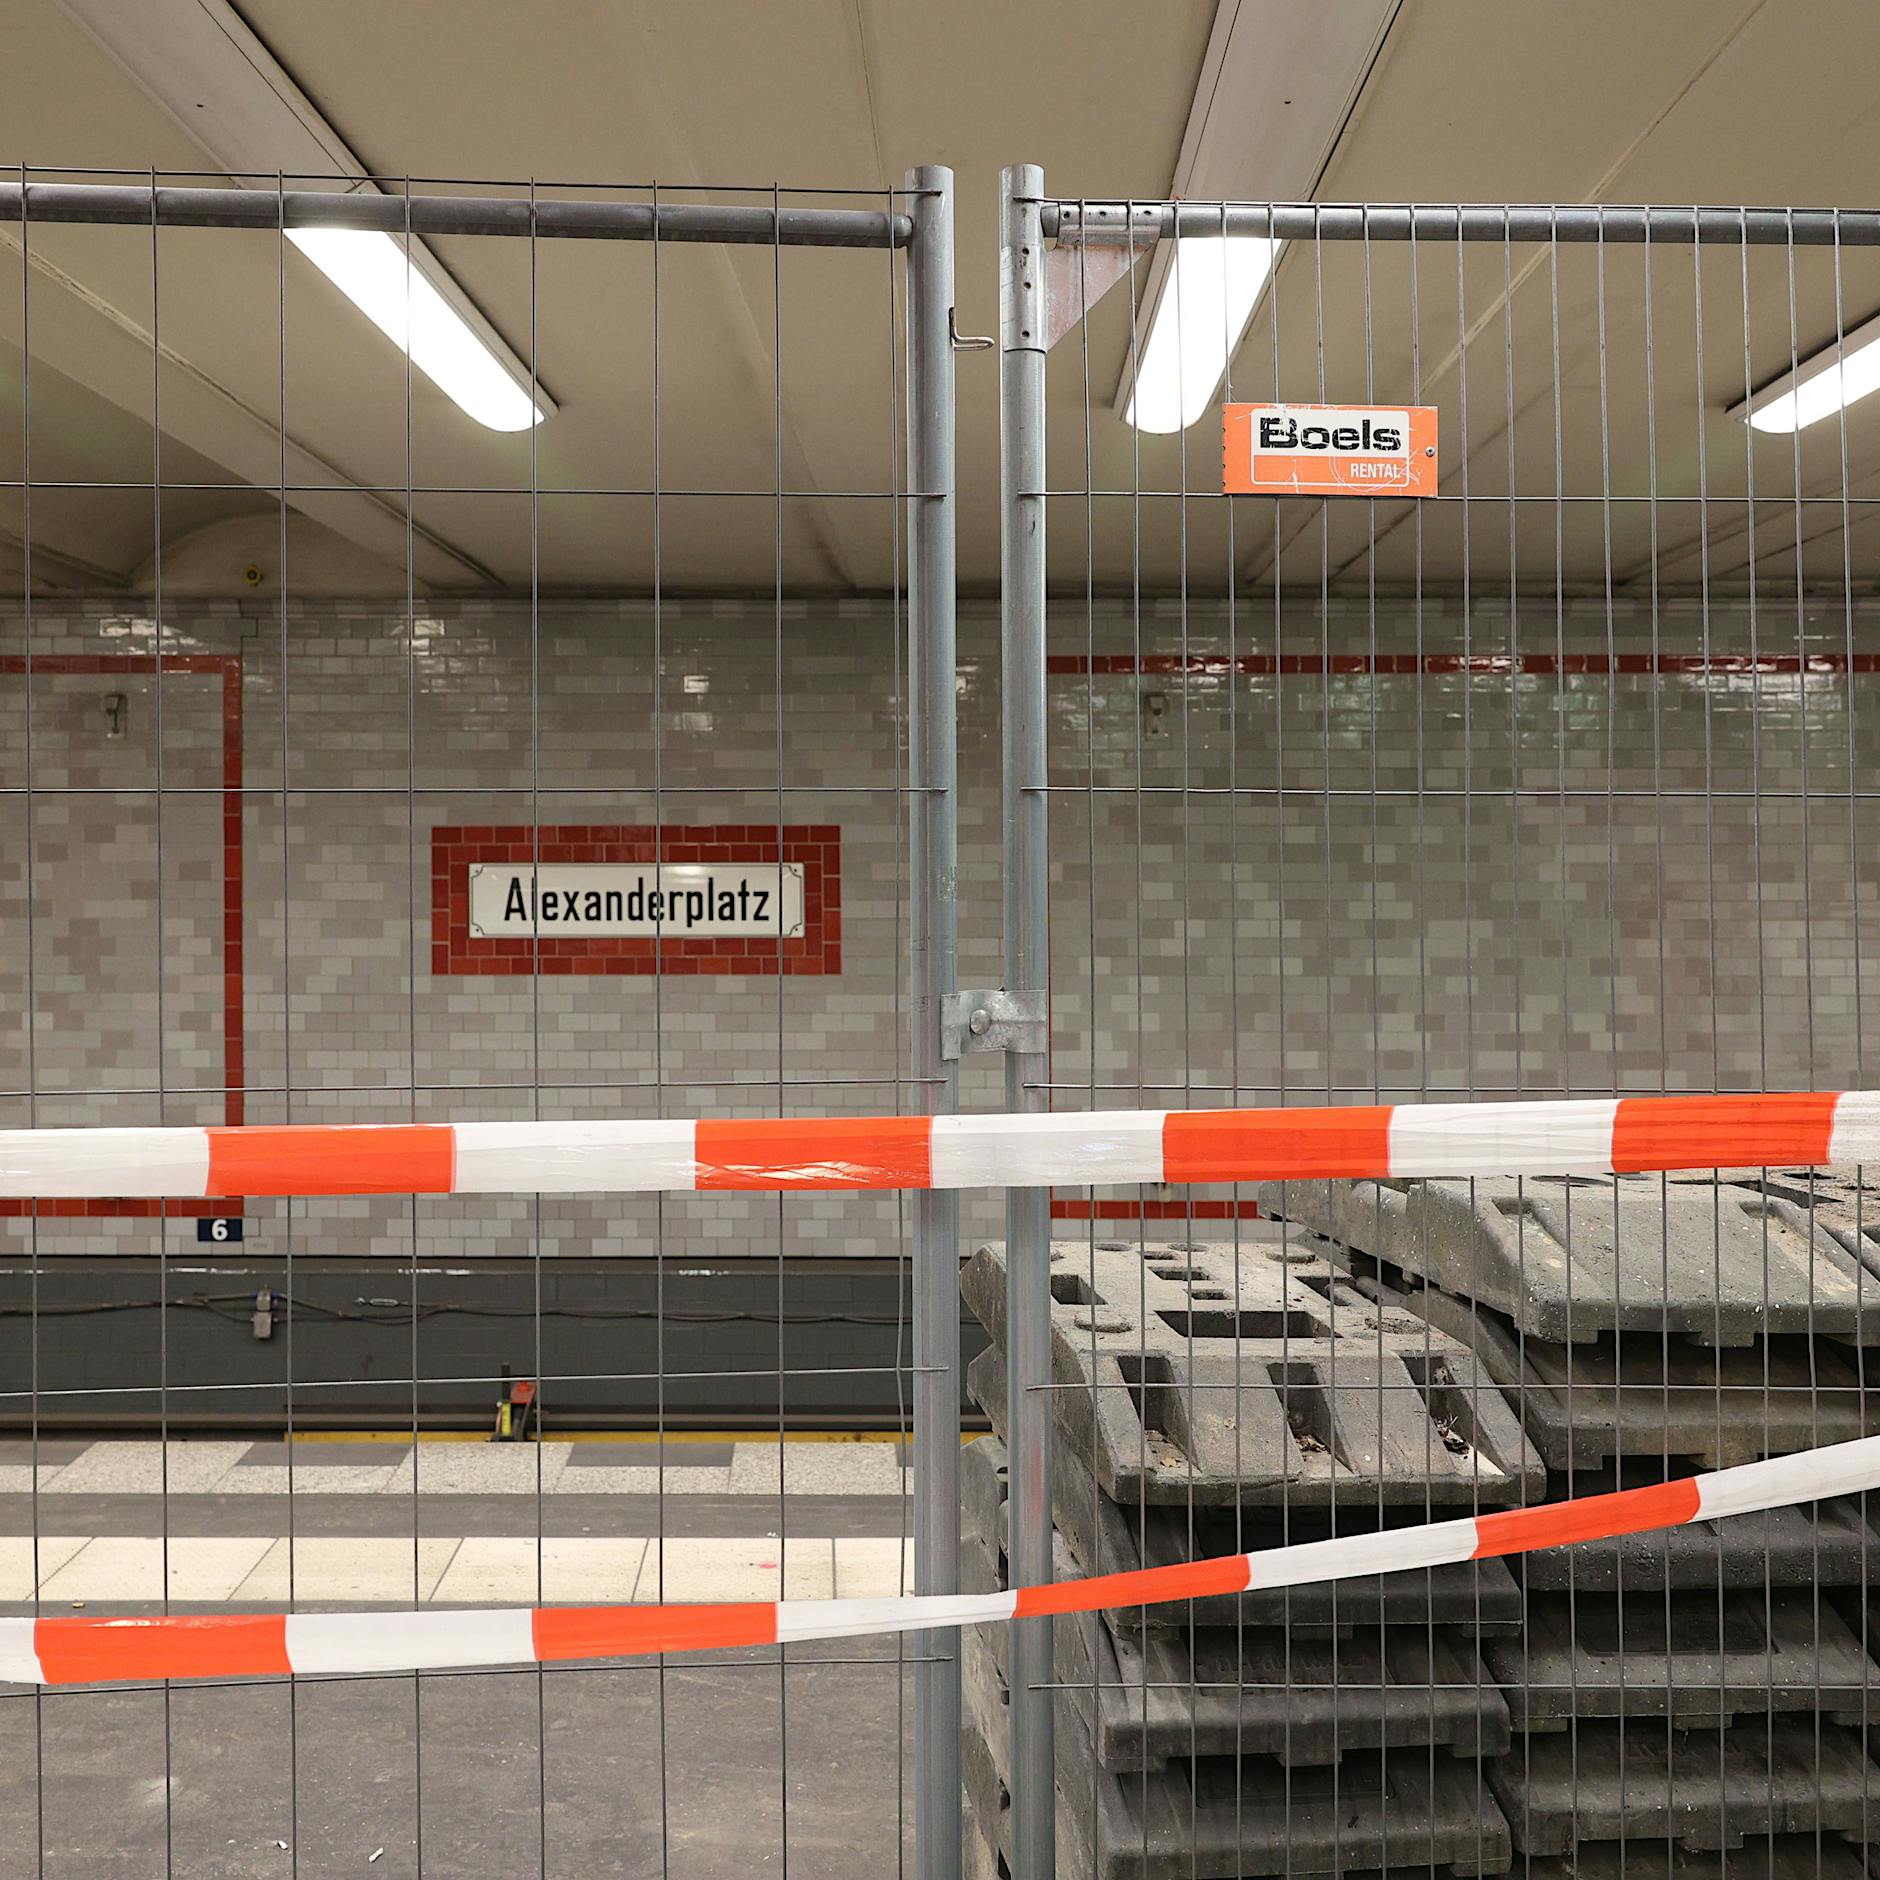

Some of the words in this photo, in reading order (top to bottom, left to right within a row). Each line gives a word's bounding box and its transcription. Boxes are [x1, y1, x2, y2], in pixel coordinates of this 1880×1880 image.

[1260, 417, 1402, 451] Boels
[1350, 463, 1401, 479] RENTAL
[505, 877, 769, 928] Alexanderplatz
[212, 1219, 228, 1241] 6
